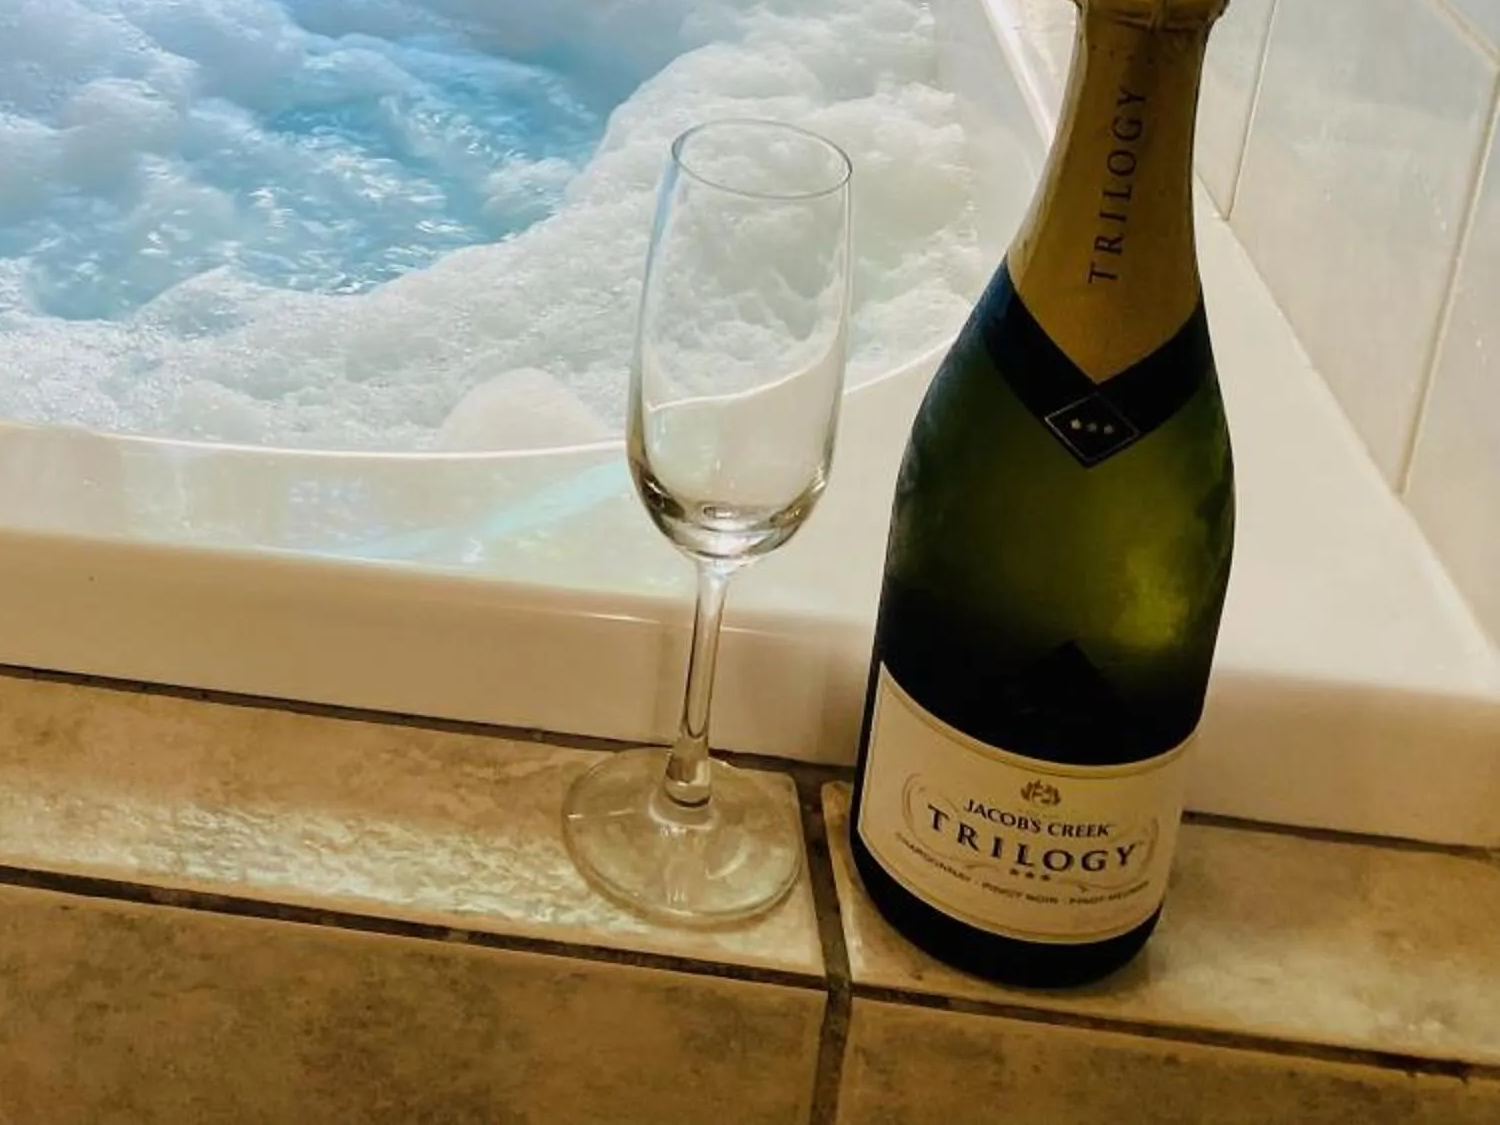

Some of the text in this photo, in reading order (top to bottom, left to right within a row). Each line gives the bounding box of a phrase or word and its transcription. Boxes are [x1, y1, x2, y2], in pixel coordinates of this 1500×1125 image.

[1087, 86, 1147, 284] TRILOGY
[927, 803, 1143, 872] TRILOGY
[963, 798, 1112, 839] JACOB'S CREEK
